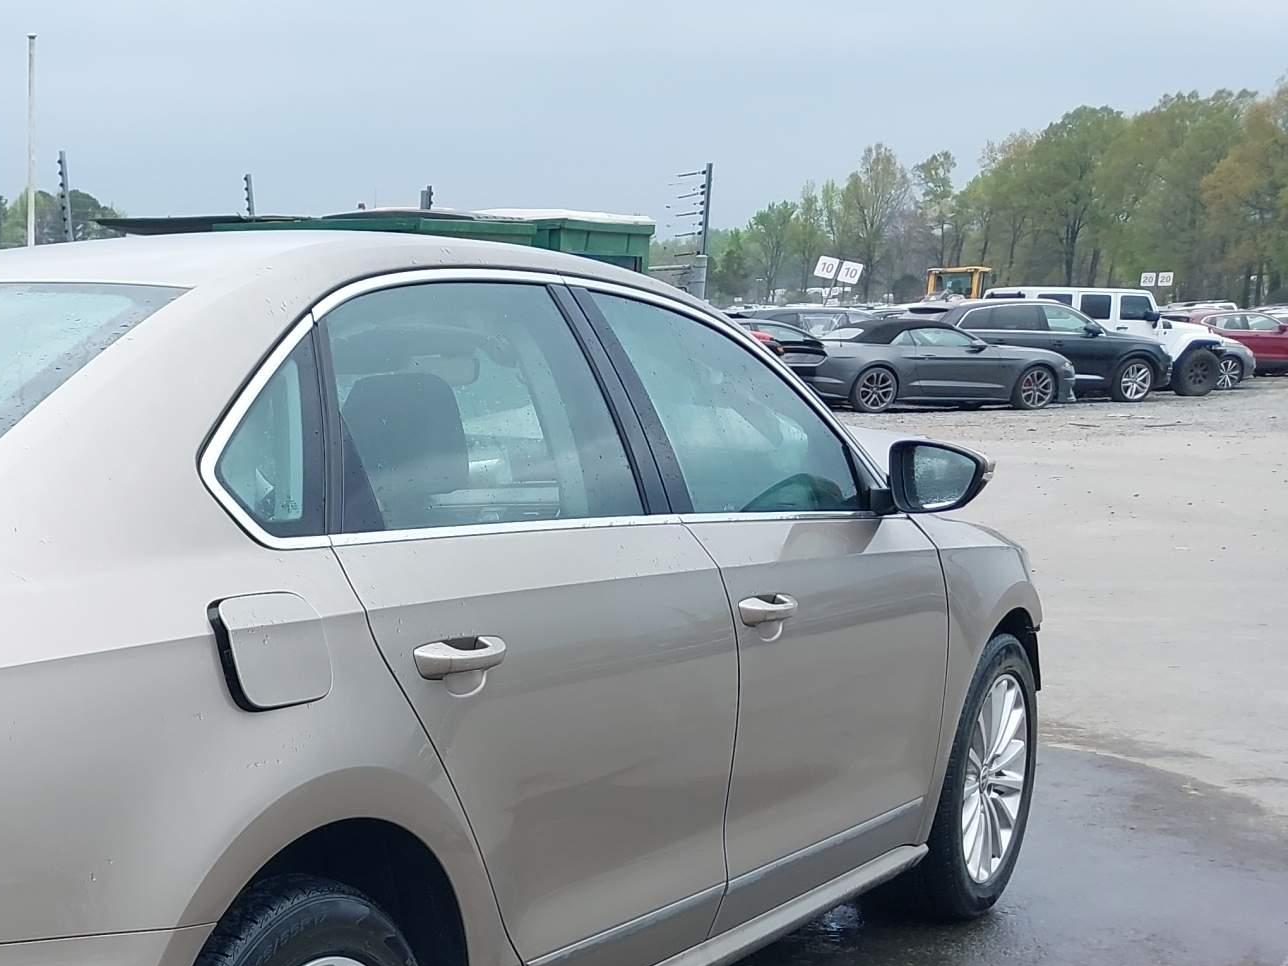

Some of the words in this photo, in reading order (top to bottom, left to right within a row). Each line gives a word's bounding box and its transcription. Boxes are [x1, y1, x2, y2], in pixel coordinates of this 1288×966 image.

[820, 262, 834, 274] 10
[843, 267, 858, 279] 10
[1142, 275, 1154, 284] 20
[1159, 275, 1171, 284] 20
